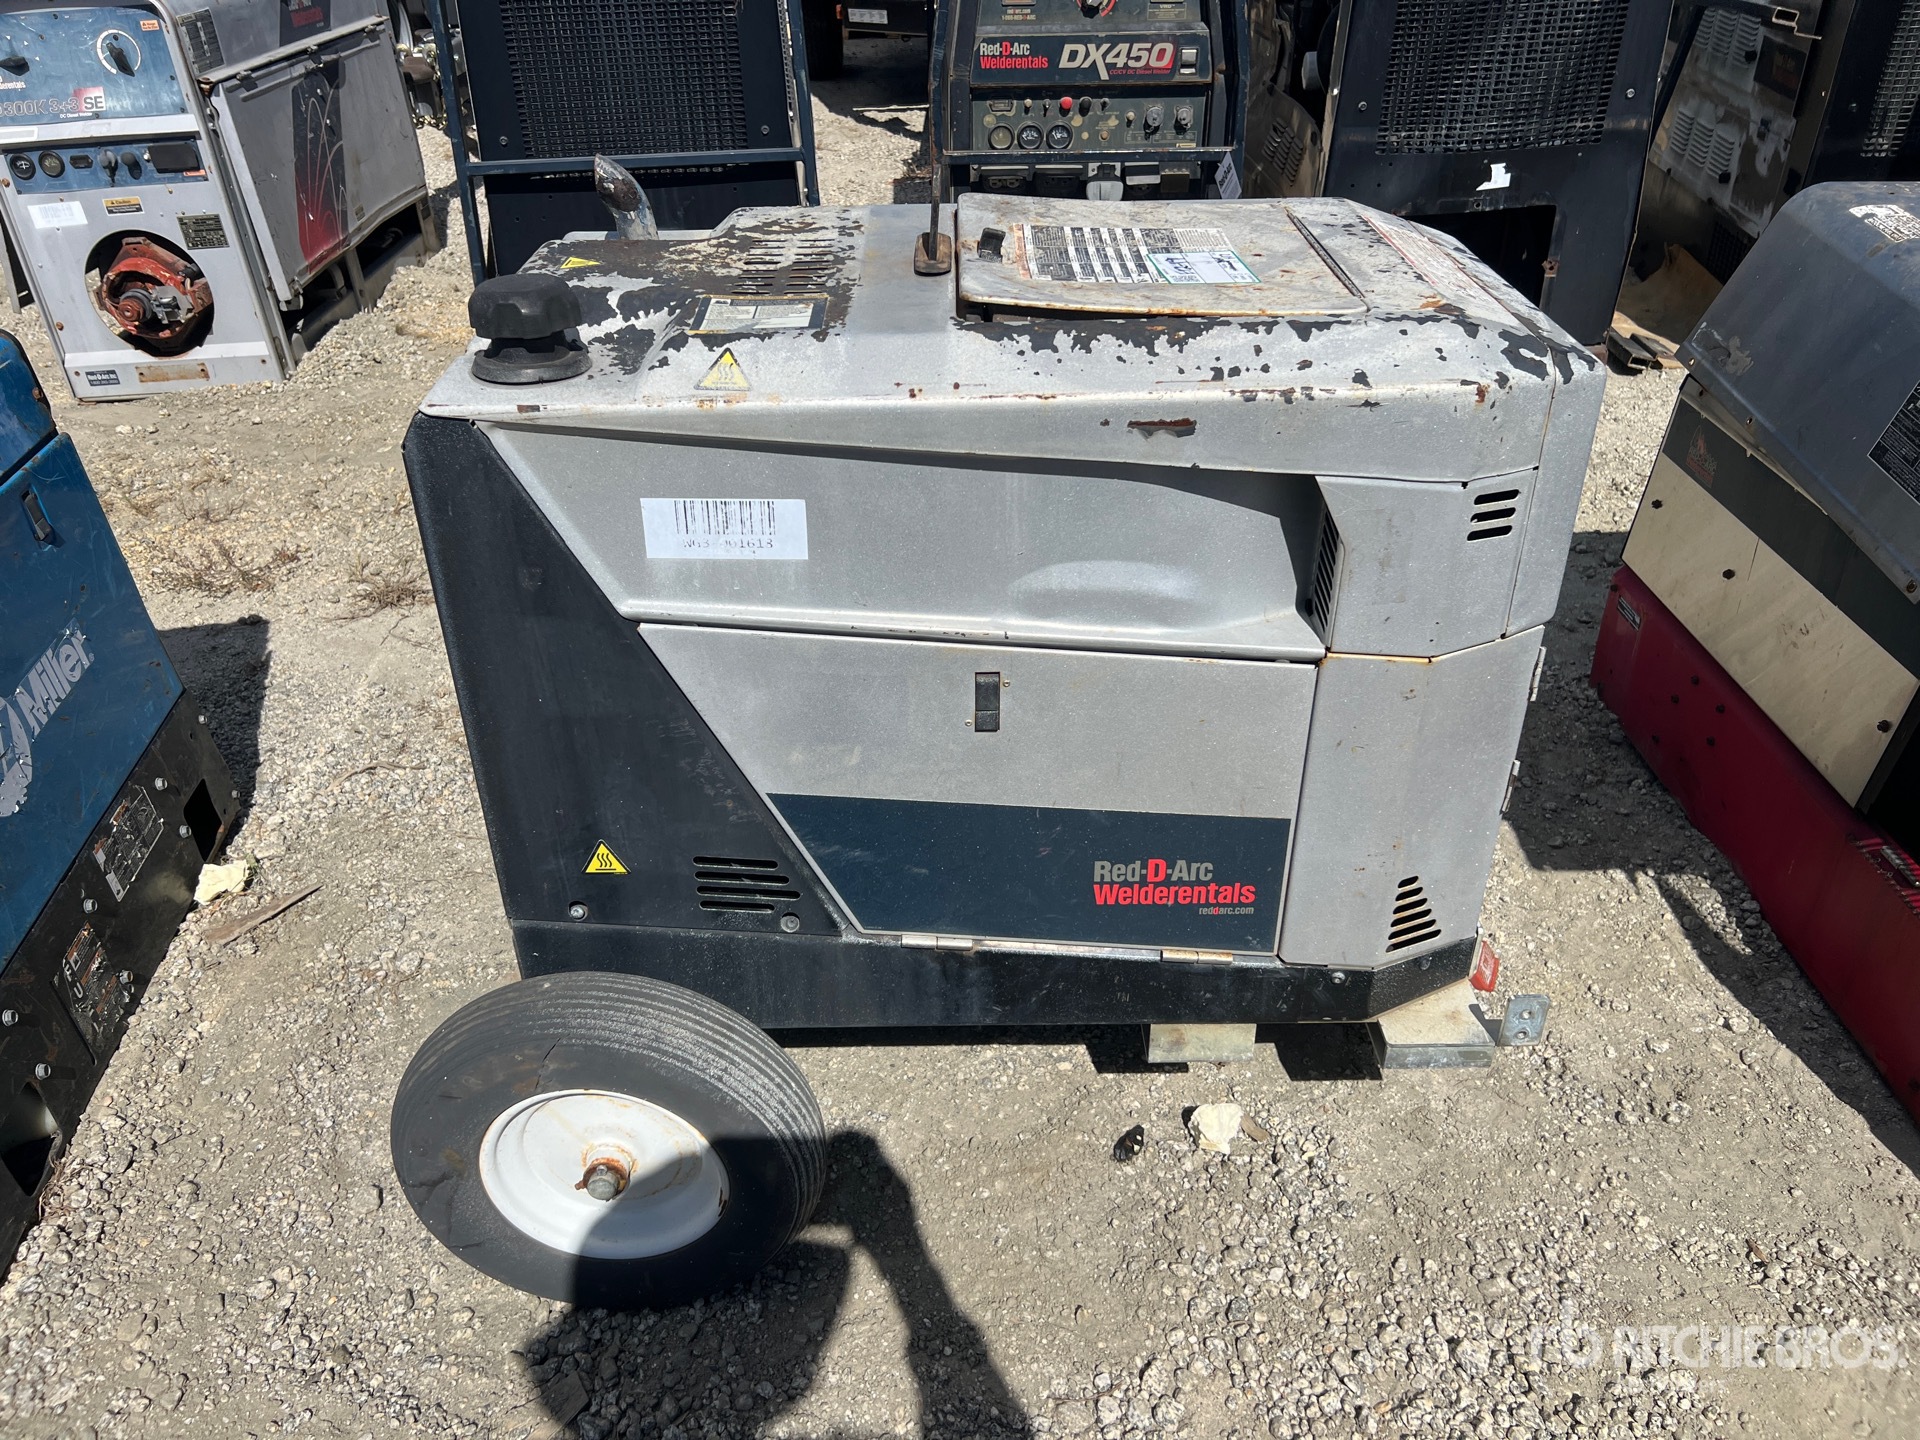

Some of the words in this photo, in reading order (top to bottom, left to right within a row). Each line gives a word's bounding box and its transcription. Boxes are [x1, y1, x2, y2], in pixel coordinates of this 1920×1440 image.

[979, 41, 1031, 56] Red-D-Arc
[979, 55, 1049, 69] Welderentals
[1058, 42, 1175, 81] DX450
[83, 95, 104, 110] SE
[16, 628, 91, 738] Miller
[1093, 857, 1214, 883] Red-D-Arc
[1092, 882, 1257, 906] Welderentals
[1198, 906, 1255, 915] reddarc.com
